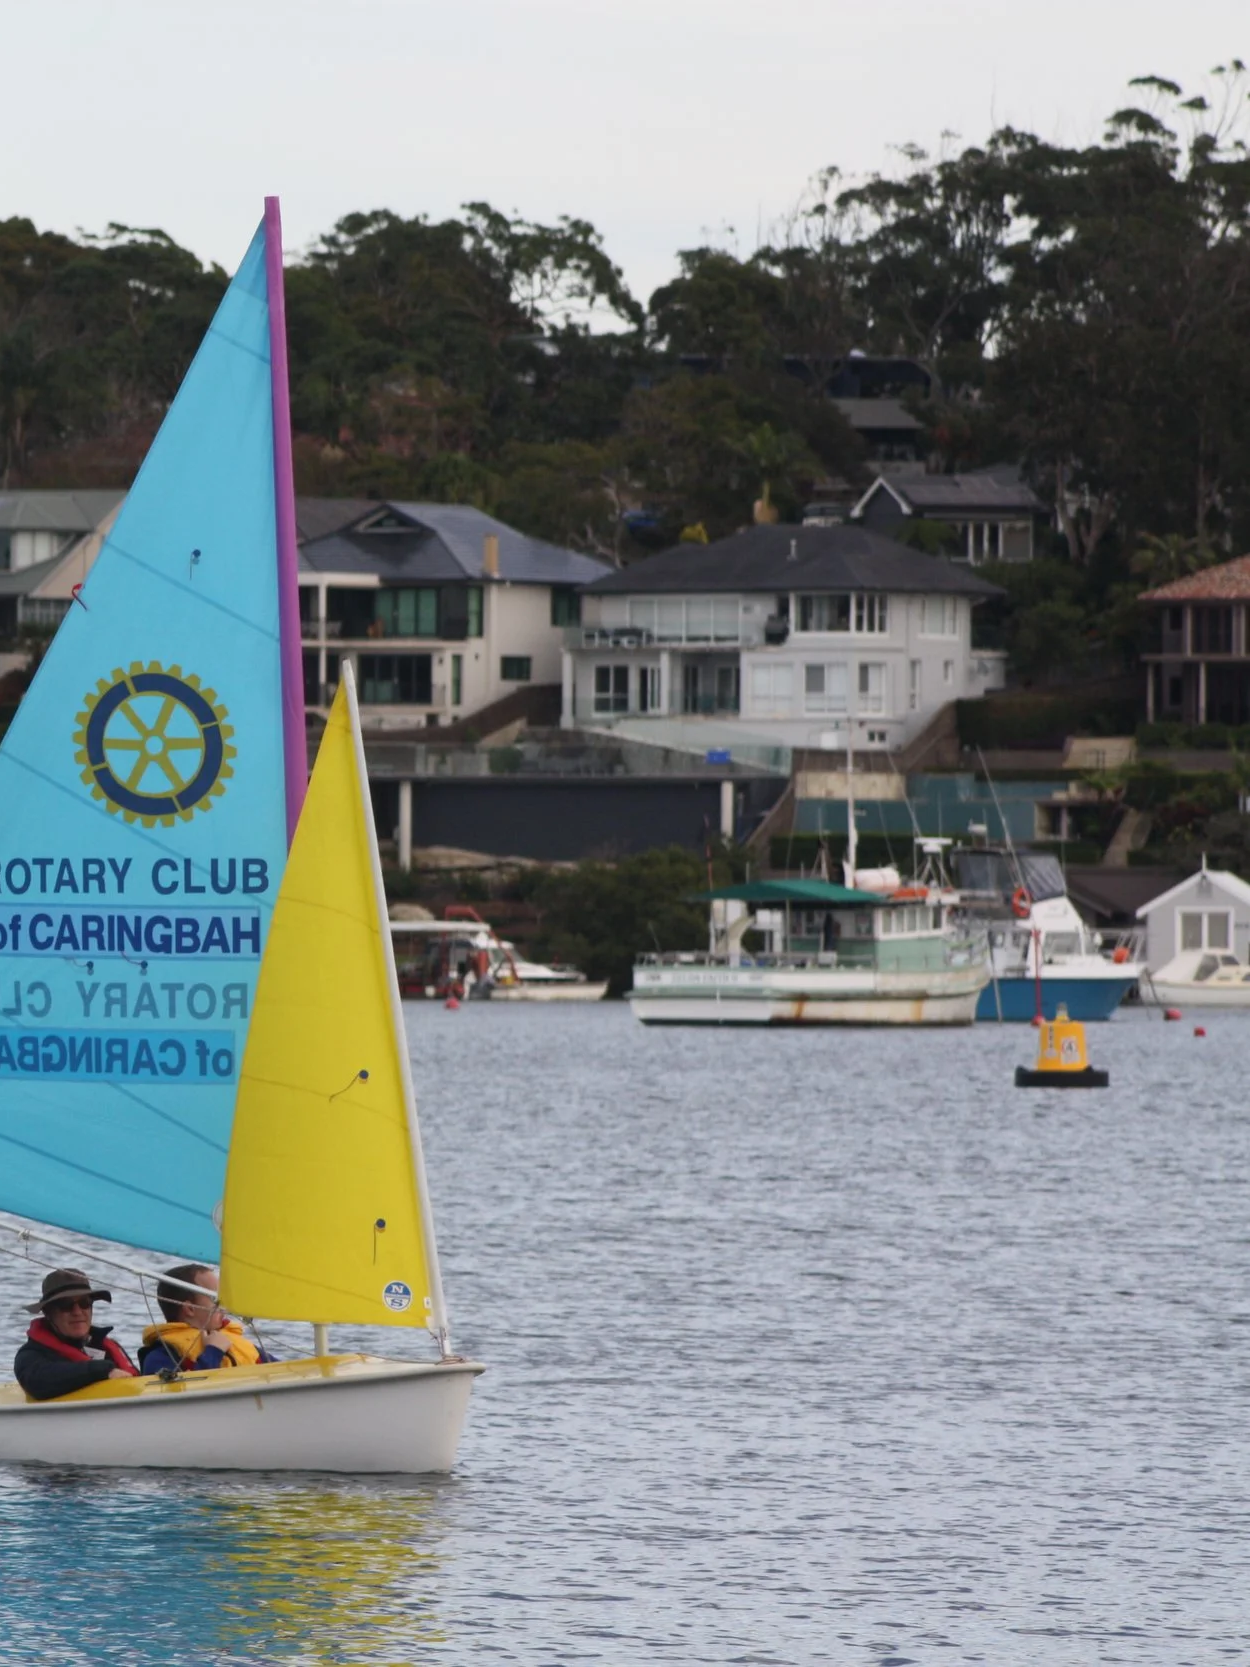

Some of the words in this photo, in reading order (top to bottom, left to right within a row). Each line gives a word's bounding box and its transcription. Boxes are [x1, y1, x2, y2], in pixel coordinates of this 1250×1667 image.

[152, 858, 269, 895] CLUB
[29, 913, 261, 954] CARINGBAH
[391, 1284, 404, 1294] N
[390, 1298, 403, 1307] S
